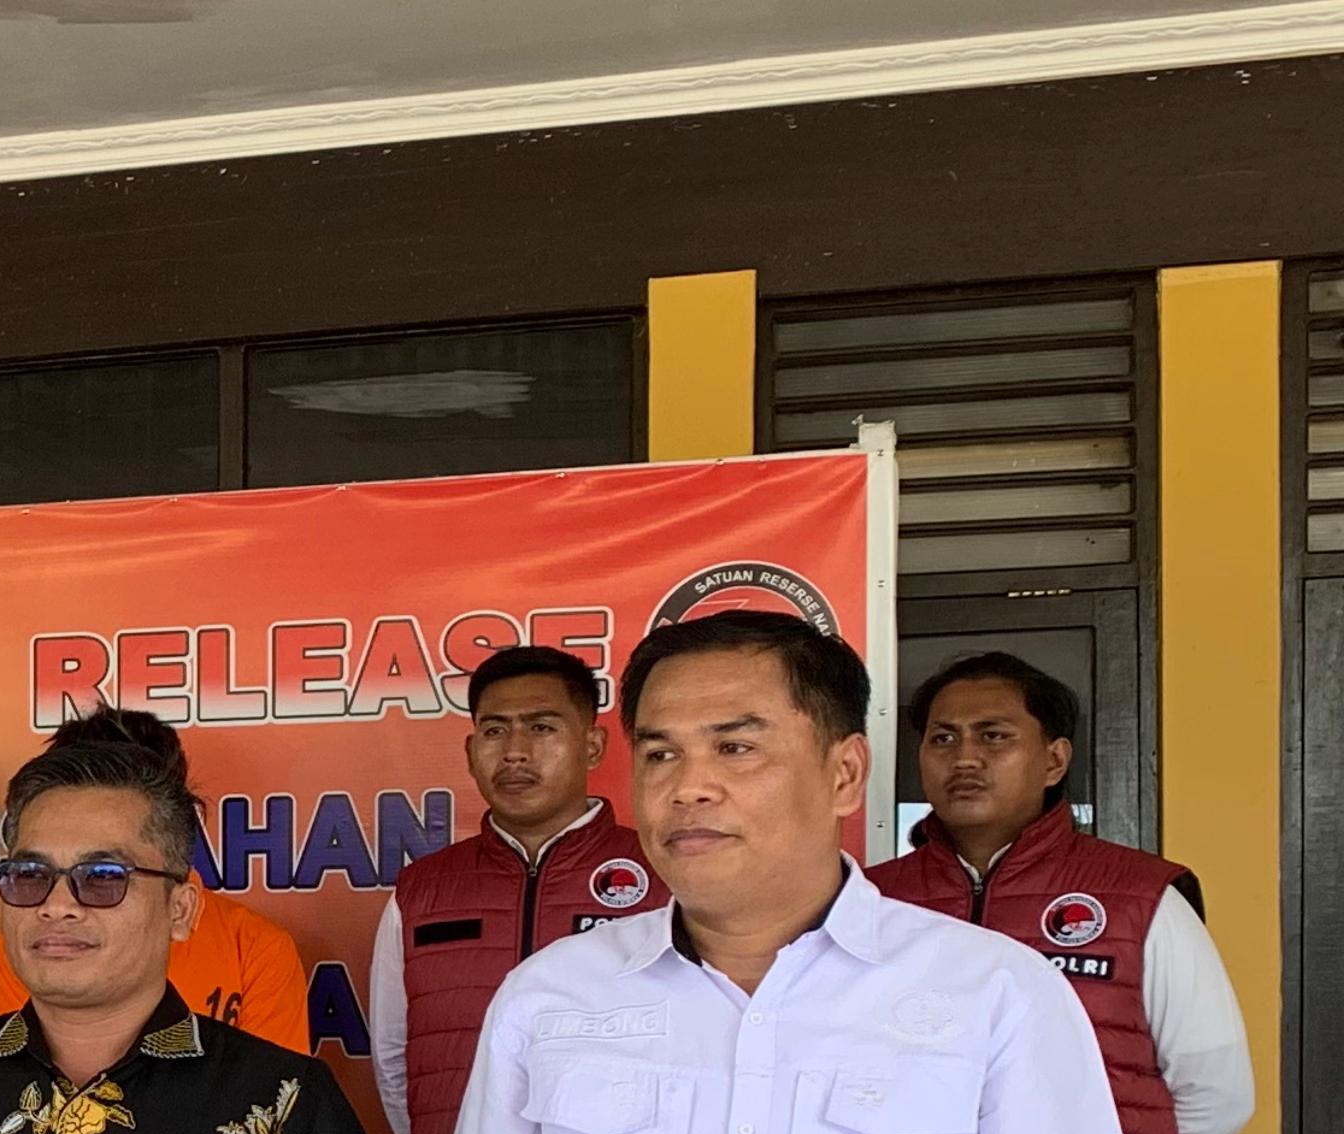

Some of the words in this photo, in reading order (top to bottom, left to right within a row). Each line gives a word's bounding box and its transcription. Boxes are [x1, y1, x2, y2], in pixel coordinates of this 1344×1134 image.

[694, 570, 753, 594] SATUAN
[760, 571, 820, 614] RESERSE
[32, 606, 613, 734] RELEASE
[1049, 956, 1108, 976] OLRI
[206, 986, 242, 1025] 16
